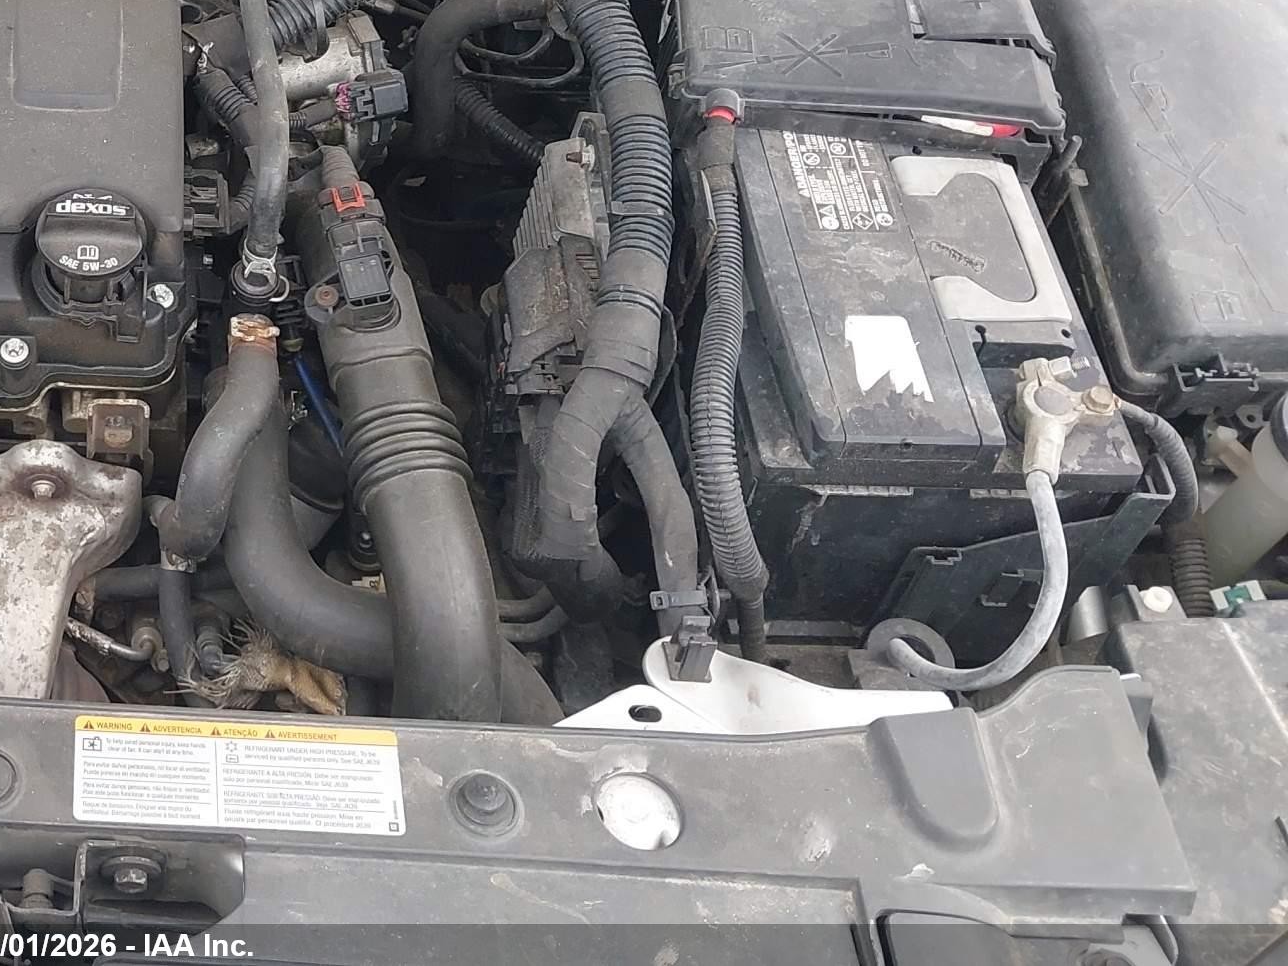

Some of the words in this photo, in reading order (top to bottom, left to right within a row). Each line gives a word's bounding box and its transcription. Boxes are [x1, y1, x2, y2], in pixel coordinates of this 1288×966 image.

[55, 199, 127, 216] dexos
[58, 255, 80, 270] SAE
[82, 257, 118, 271] 5W-30
[96, 722, 133, 730] WARNING
[153, 725, 202, 734] ADVERTENCIA
[223, 728, 258, 737] ATENÇÃO
[278, 731, 337, 741] AVERTISSEMENT
[244, 745, 285, 753] REFRIGERANT
